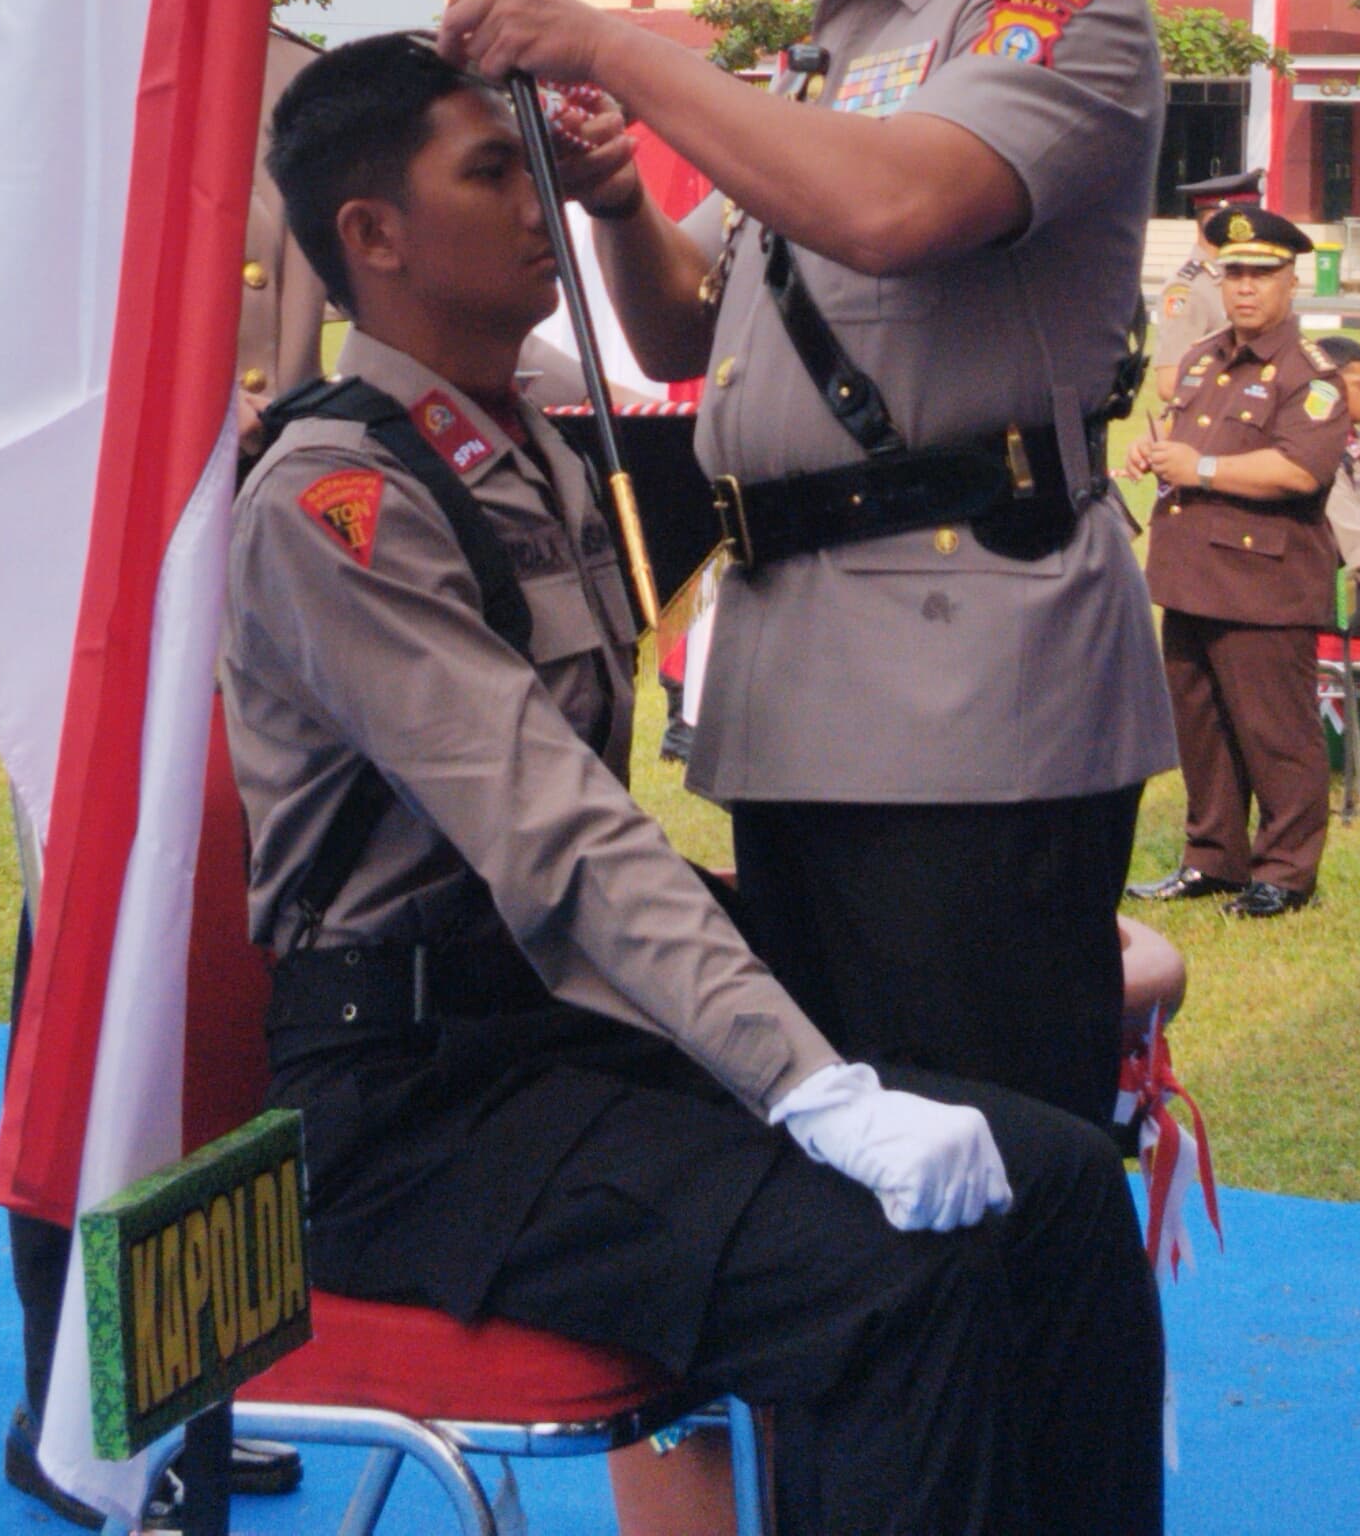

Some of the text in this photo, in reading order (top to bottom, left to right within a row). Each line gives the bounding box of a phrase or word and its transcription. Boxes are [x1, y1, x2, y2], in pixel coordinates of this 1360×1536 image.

[453, 438, 486, 467] SPN
[327, 499, 372, 526] TON
[347, 521, 369, 548] II
[132, 1159, 306, 1414] KAPOLDA
